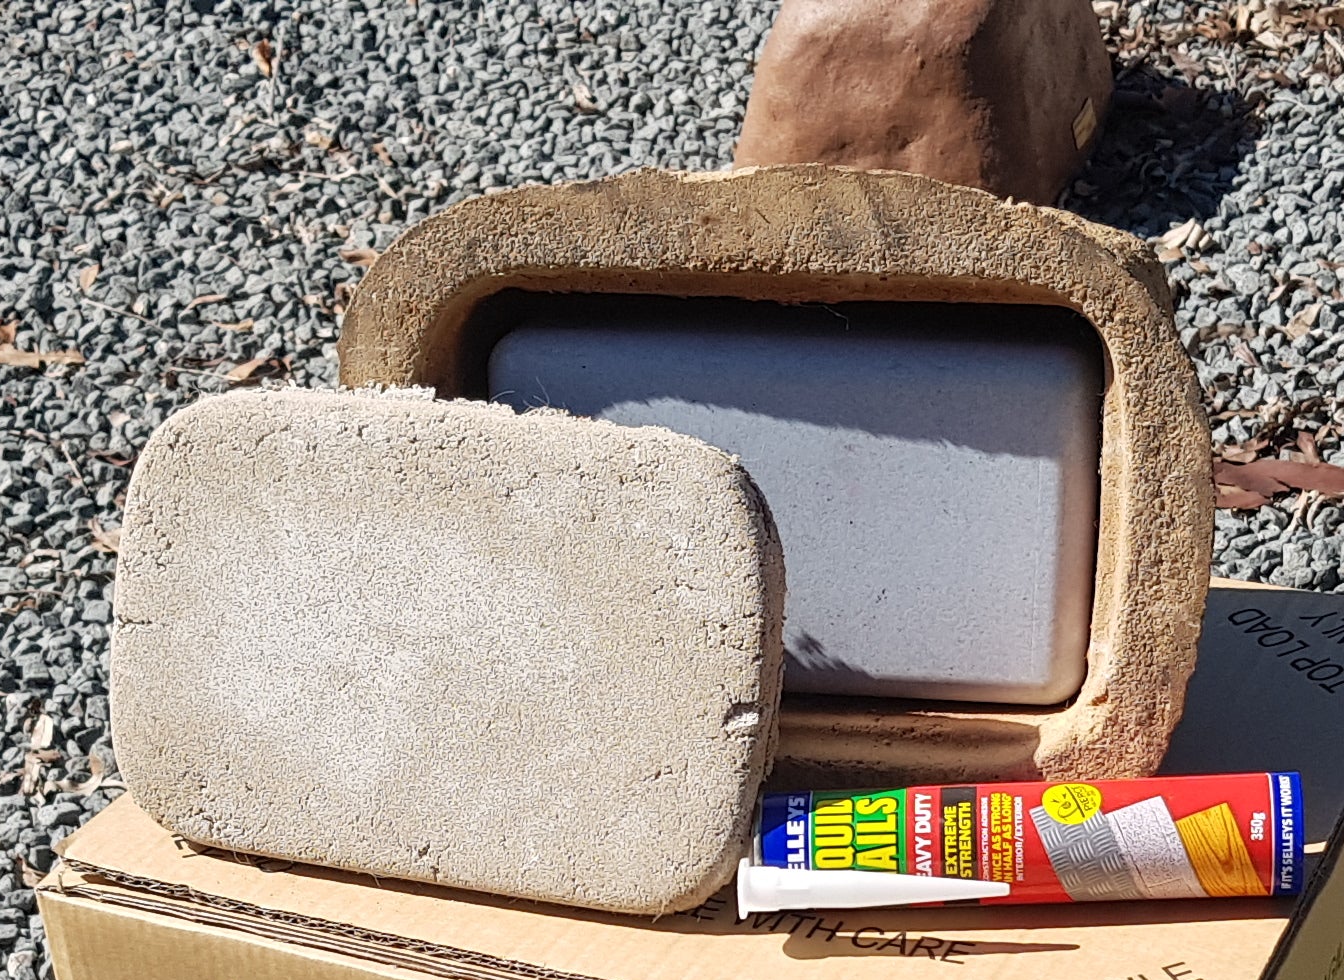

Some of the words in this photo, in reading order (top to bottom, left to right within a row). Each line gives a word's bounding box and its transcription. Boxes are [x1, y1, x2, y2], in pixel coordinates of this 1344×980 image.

[1227, 608, 1309, 657] LOAD
[914, 793, 932, 833] DUTY
[990, 793, 1002, 833] STRONG
[1002, 824, 1013, 840] AS
[1250, 812, 1266, 841] 350g
[1280, 806, 1293, 818] IT
[786, 797, 806, 870] ELLEYS
[814, 798, 856, 871] QUID
[855, 797, 899, 877] AILS
[943, 806, 958, 875] EXTREME
[957, 801, 973, 878] STRENGTH
[991, 835, 1002, 851] AS
[1281, 819, 1294, 865] SELLEYS
[914, 836, 933, 878] EAVY
[1002, 842, 1013, 871] HALF
[1003, 872, 1014, 883] IN
[852, 926, 976, 965] CARE
